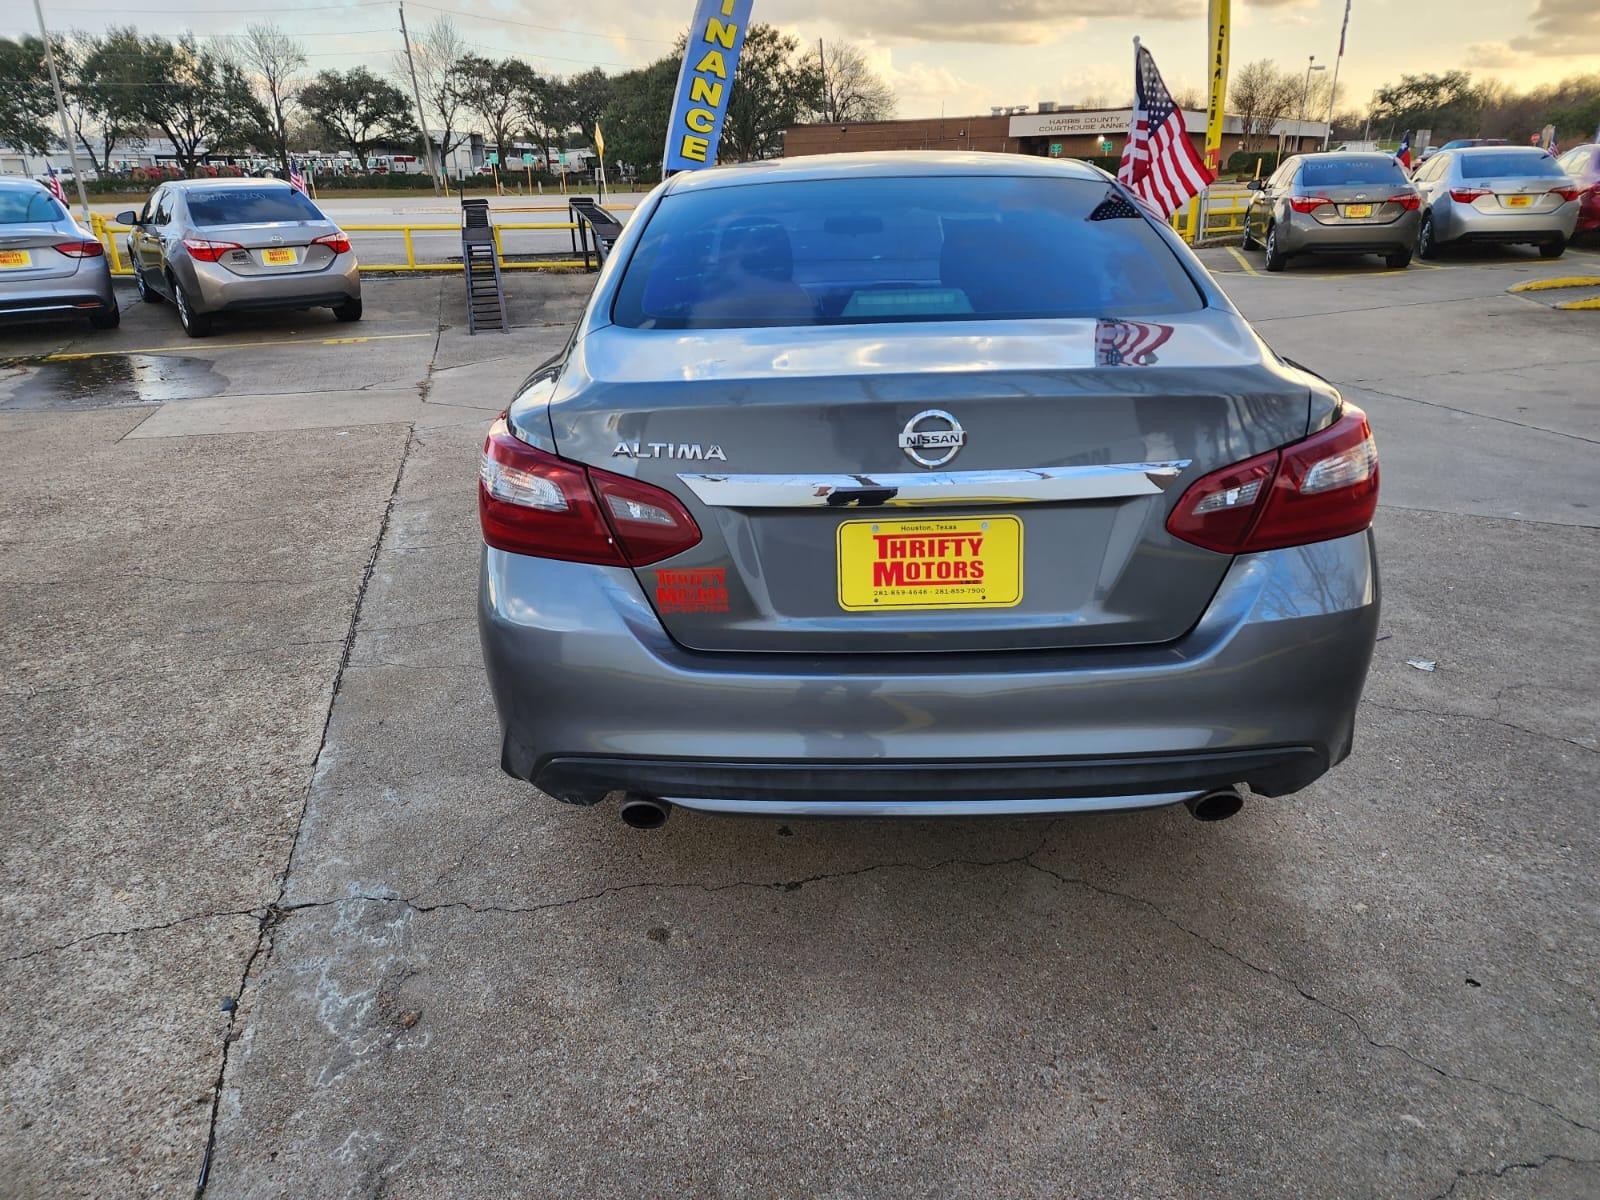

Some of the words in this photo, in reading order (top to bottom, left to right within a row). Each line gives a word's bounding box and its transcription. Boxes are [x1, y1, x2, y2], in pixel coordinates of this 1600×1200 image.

[1038, 124, 1096, 132] COURTHOUSE
[1083, 116, 1121, 124] COUNTY
[906, 434, 960, 447] NISSAN
[612, 441, 728, 462] ALTIMA
[873, 532, 984, 559] THRIFTY
[873, 560, 985, 588] MOTORS
